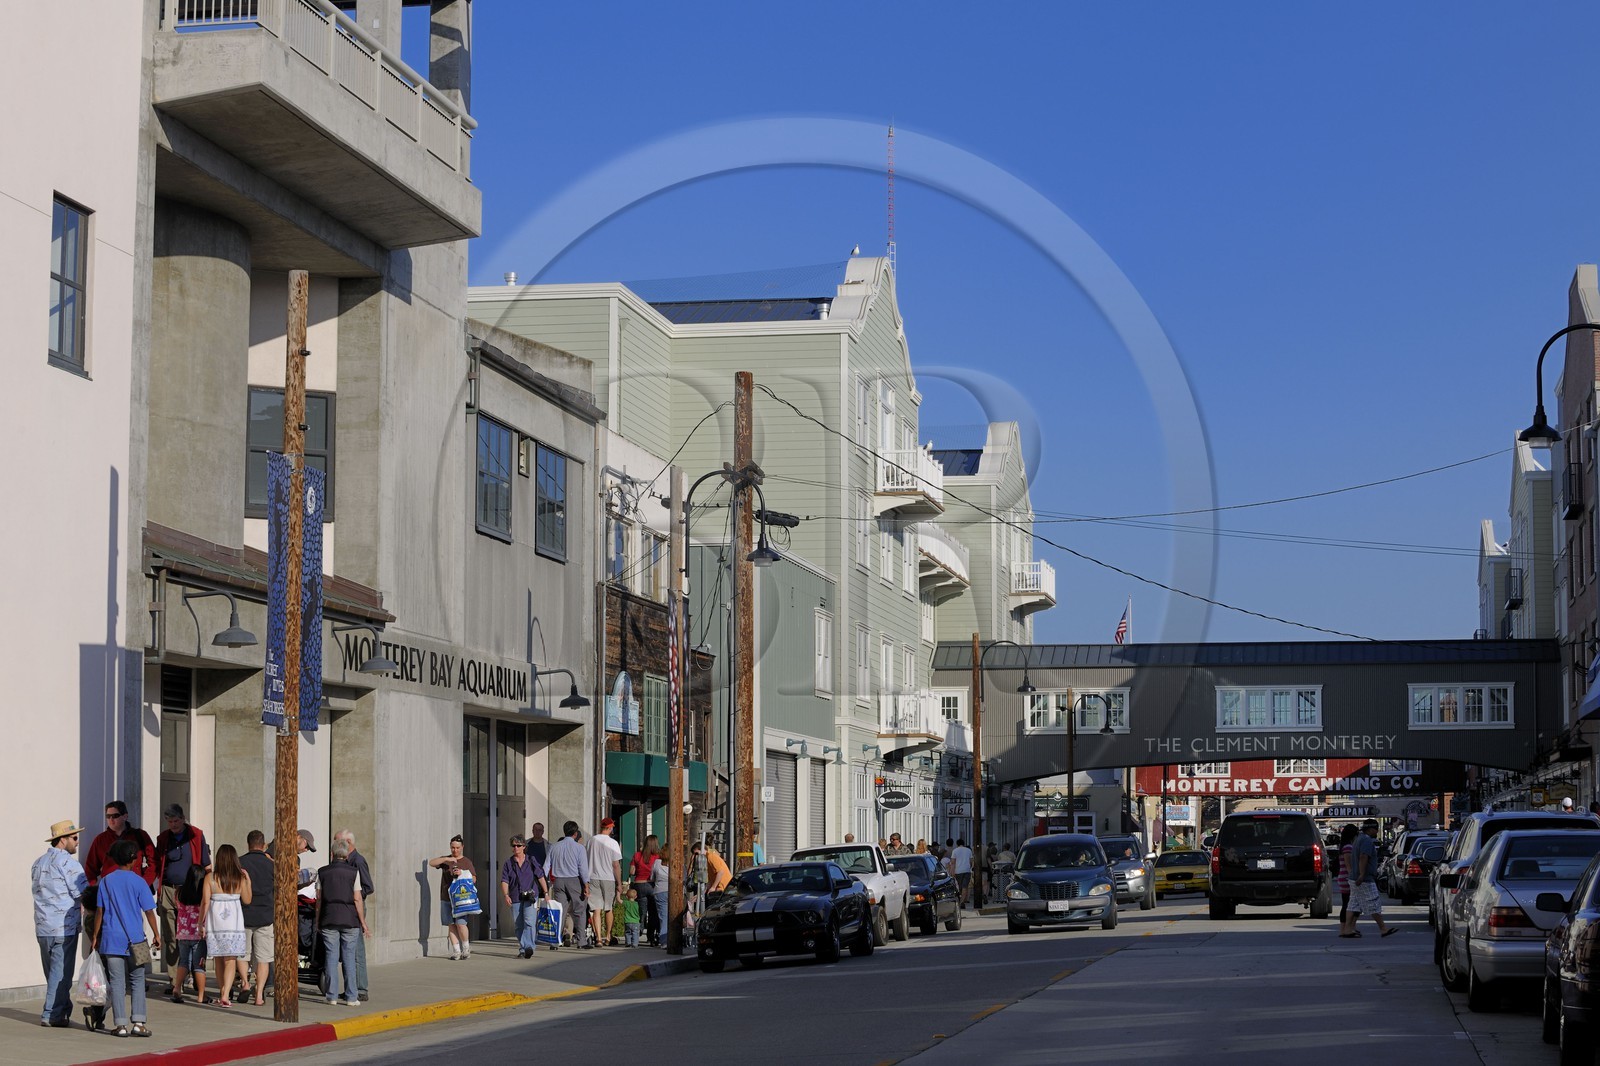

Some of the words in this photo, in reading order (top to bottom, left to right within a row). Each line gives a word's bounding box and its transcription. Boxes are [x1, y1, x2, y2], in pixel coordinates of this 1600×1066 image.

[430, 651, 455, 689] BAY
[458, 658, 527, 702] AQUARIUM
[1144, 737, 1182, 753] THE
[1190, 736, 1281, 753] CLEMENT
[1290, 735, 1397, 751] MONTEREY
[1160, 779, 1277, 793] MONTEREY
[1288, 777, 1381, 792] CANNING
[1391, 776, 1419, 790] CO.
[1328, 807, 1369, 816] COMPANY
